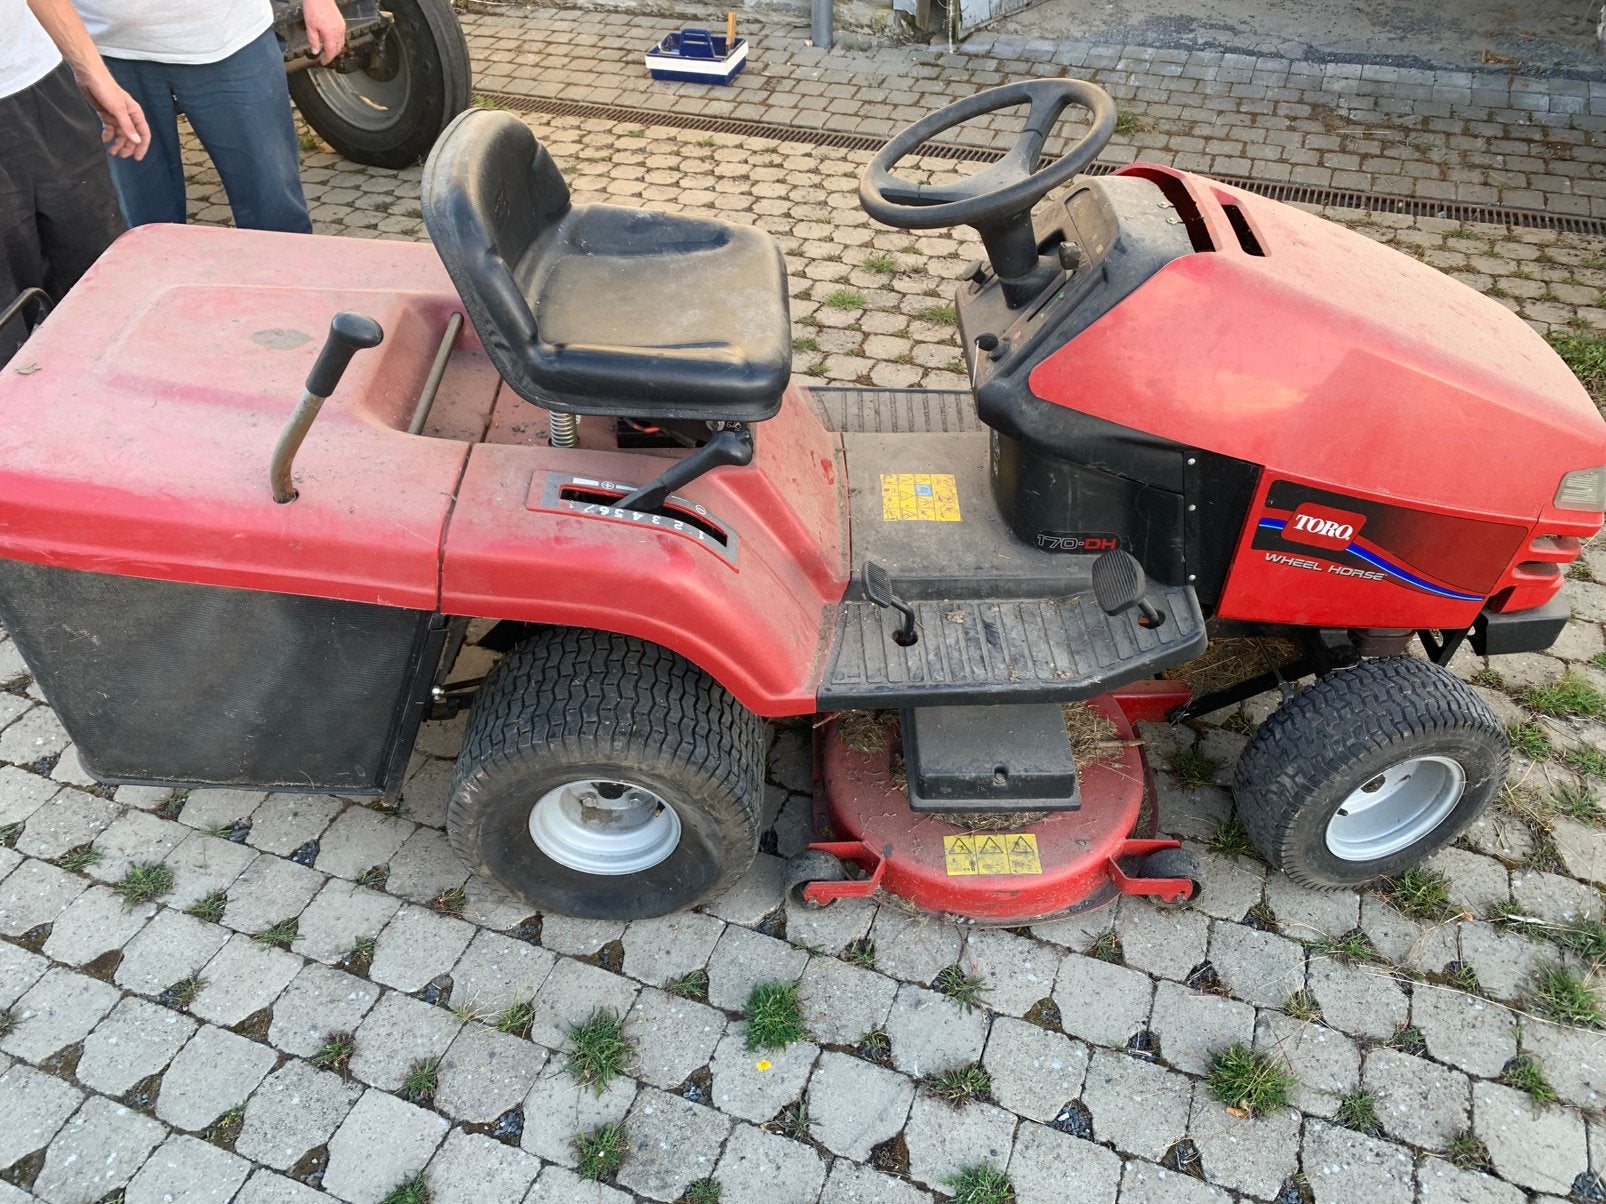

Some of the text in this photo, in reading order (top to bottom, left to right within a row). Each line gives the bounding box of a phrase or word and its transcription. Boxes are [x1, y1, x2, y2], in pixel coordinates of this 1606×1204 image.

[599, 506, 609, 515] 6
[614, 509, 624, 518] 5
[632, 512, 644, 520] 4
[651, 515, 661, 524] 3
[673, 520, 684, 530] 2
[1293, 514, 1354, 540] TORO
[1037, 534, 1117, 549] 170-DH
[1264, 552, 1385, 580] WHEEL HORSE
